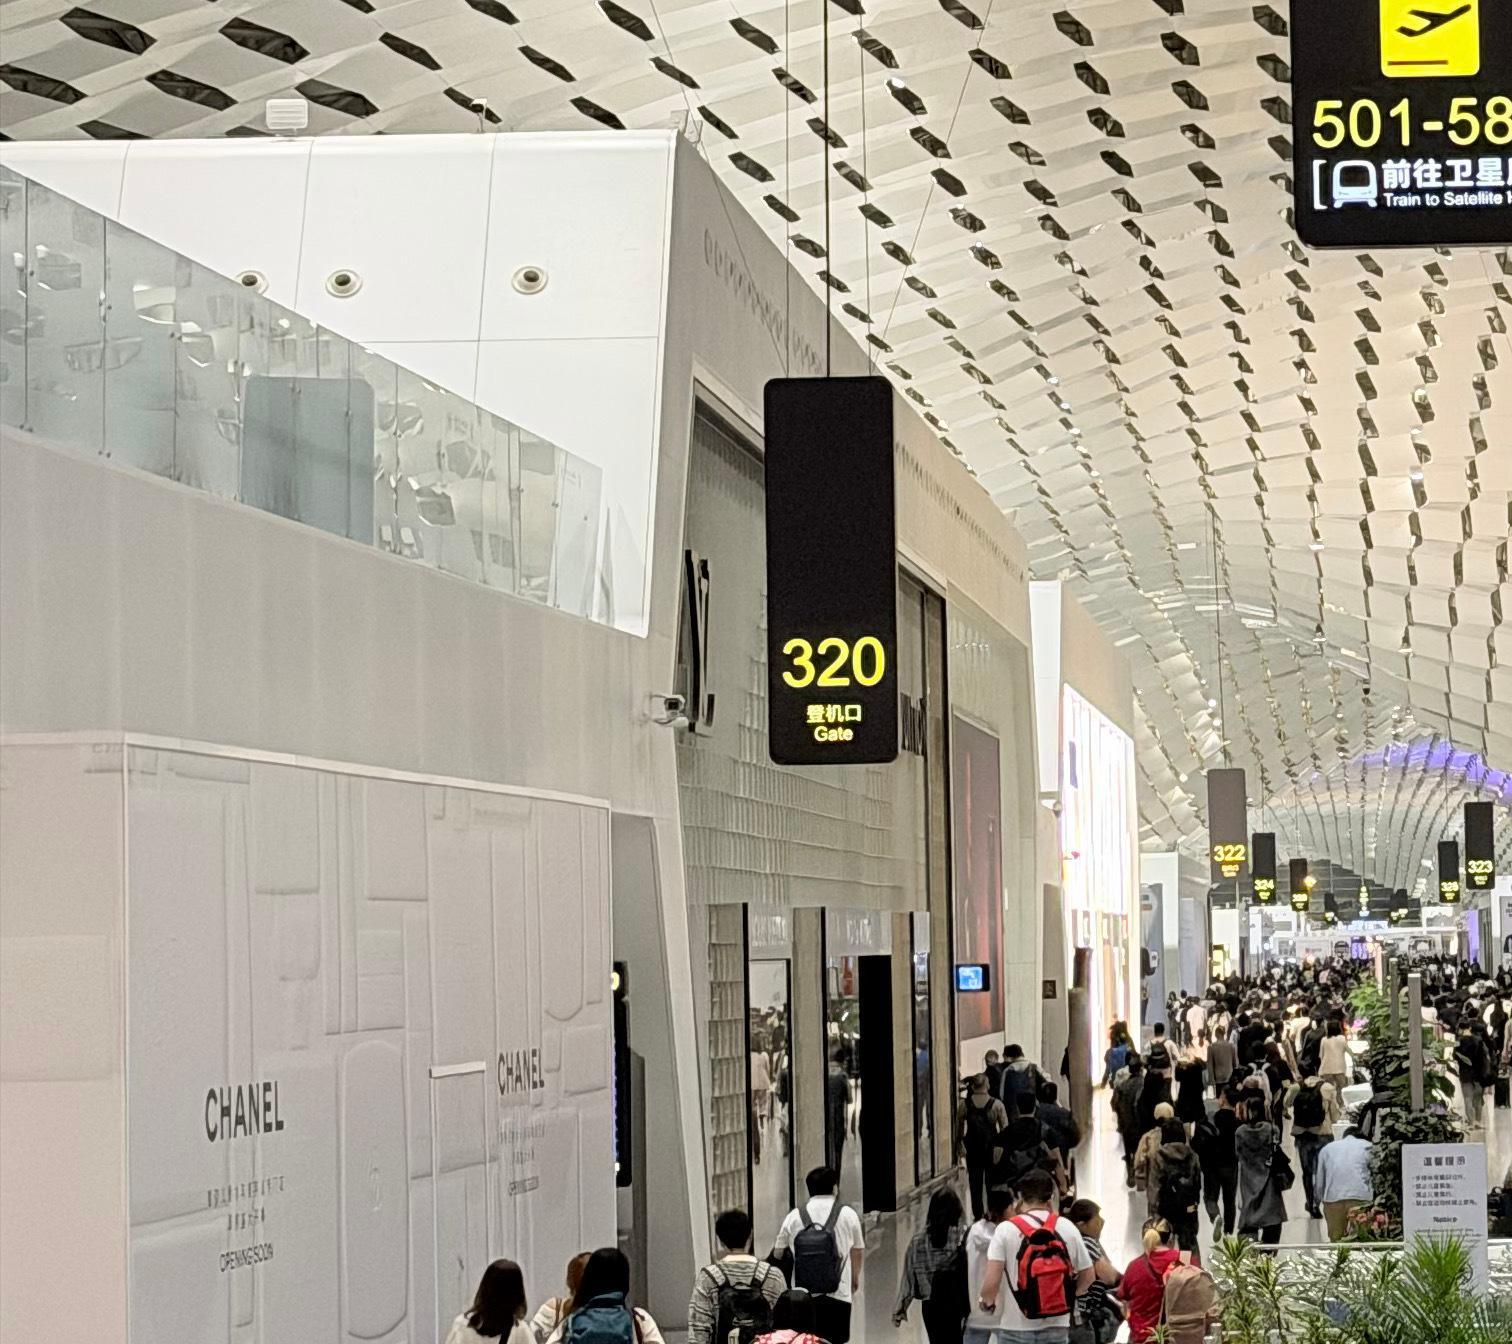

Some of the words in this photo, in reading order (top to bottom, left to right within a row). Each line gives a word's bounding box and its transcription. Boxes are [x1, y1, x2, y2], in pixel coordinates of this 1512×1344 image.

[1383, 192, 1421, 207] Train
[1425, 192, 1440, 207] to
[1444, 190, 1503, 206] Satellite
[781, 635, 886, 689] 320
[806, 703, 862, 724] 登机口
[814, 725, 855, 743] Gate
[1213, 844, 1246, 862] 322
[1467, 859, 1493, 874] 323
[497, 1047, 545, 1096] CHANEL
[205, 1080, 284, 1143] CHANEL
